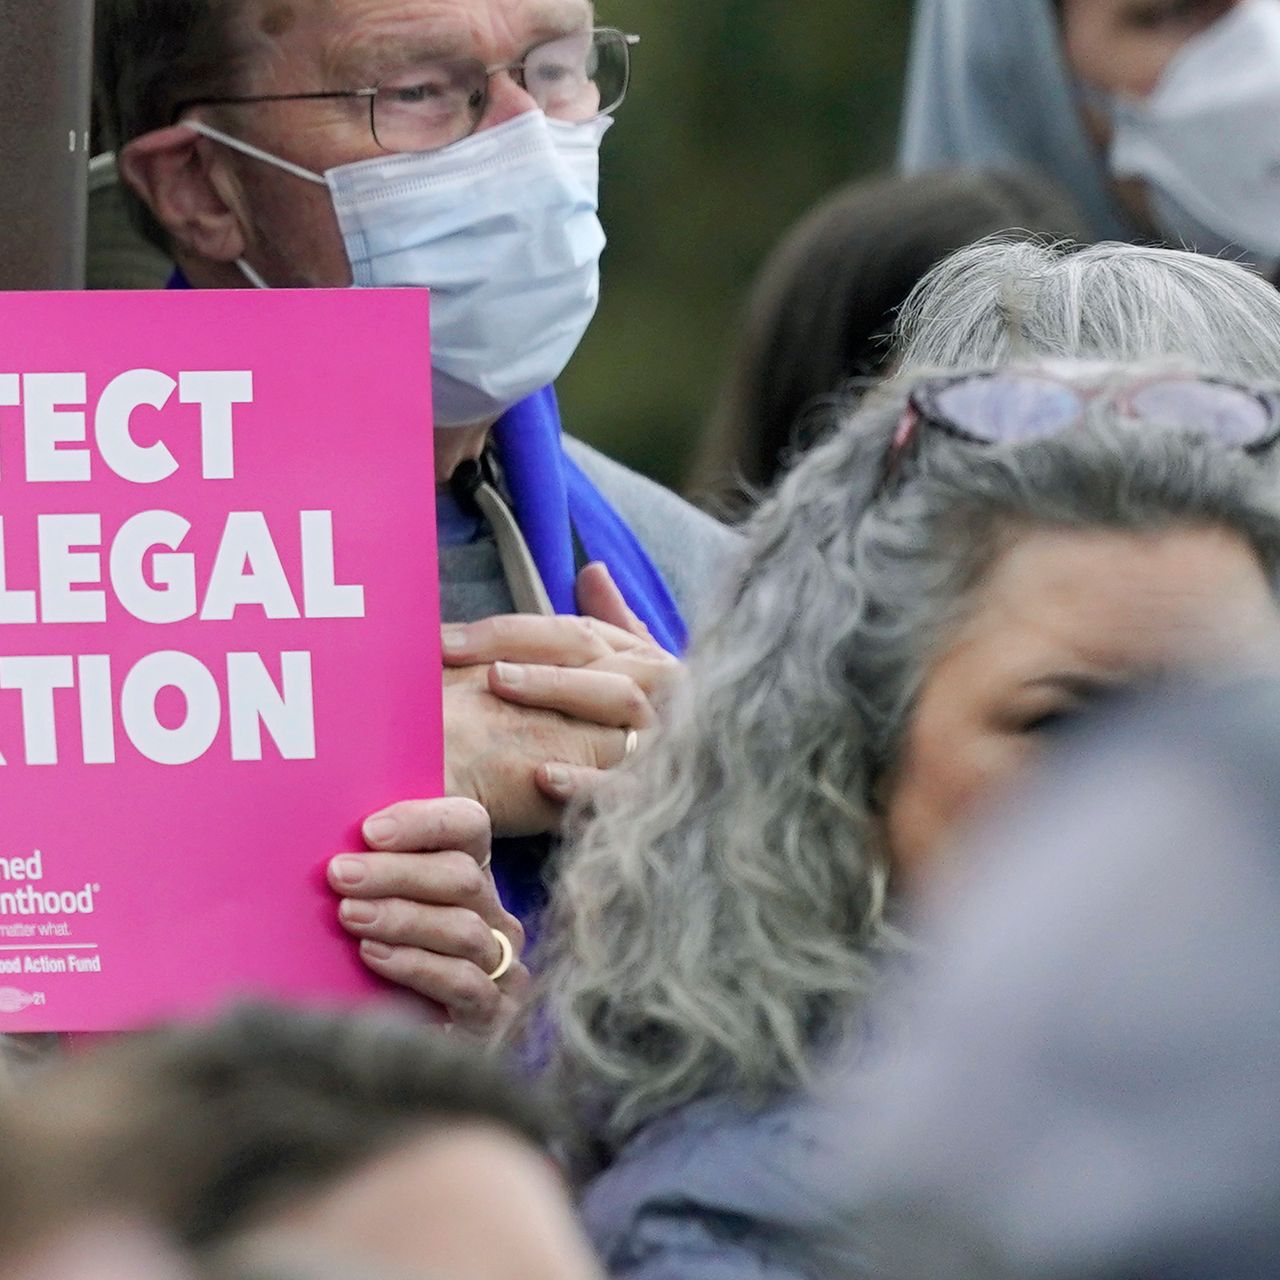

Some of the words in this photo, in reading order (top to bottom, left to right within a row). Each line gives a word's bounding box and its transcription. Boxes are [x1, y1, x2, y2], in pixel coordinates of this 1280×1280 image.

[39, 920, 72, 936] what.
[24, 956, 66, 974] Action
[68, 954, 102, 972] Fund
